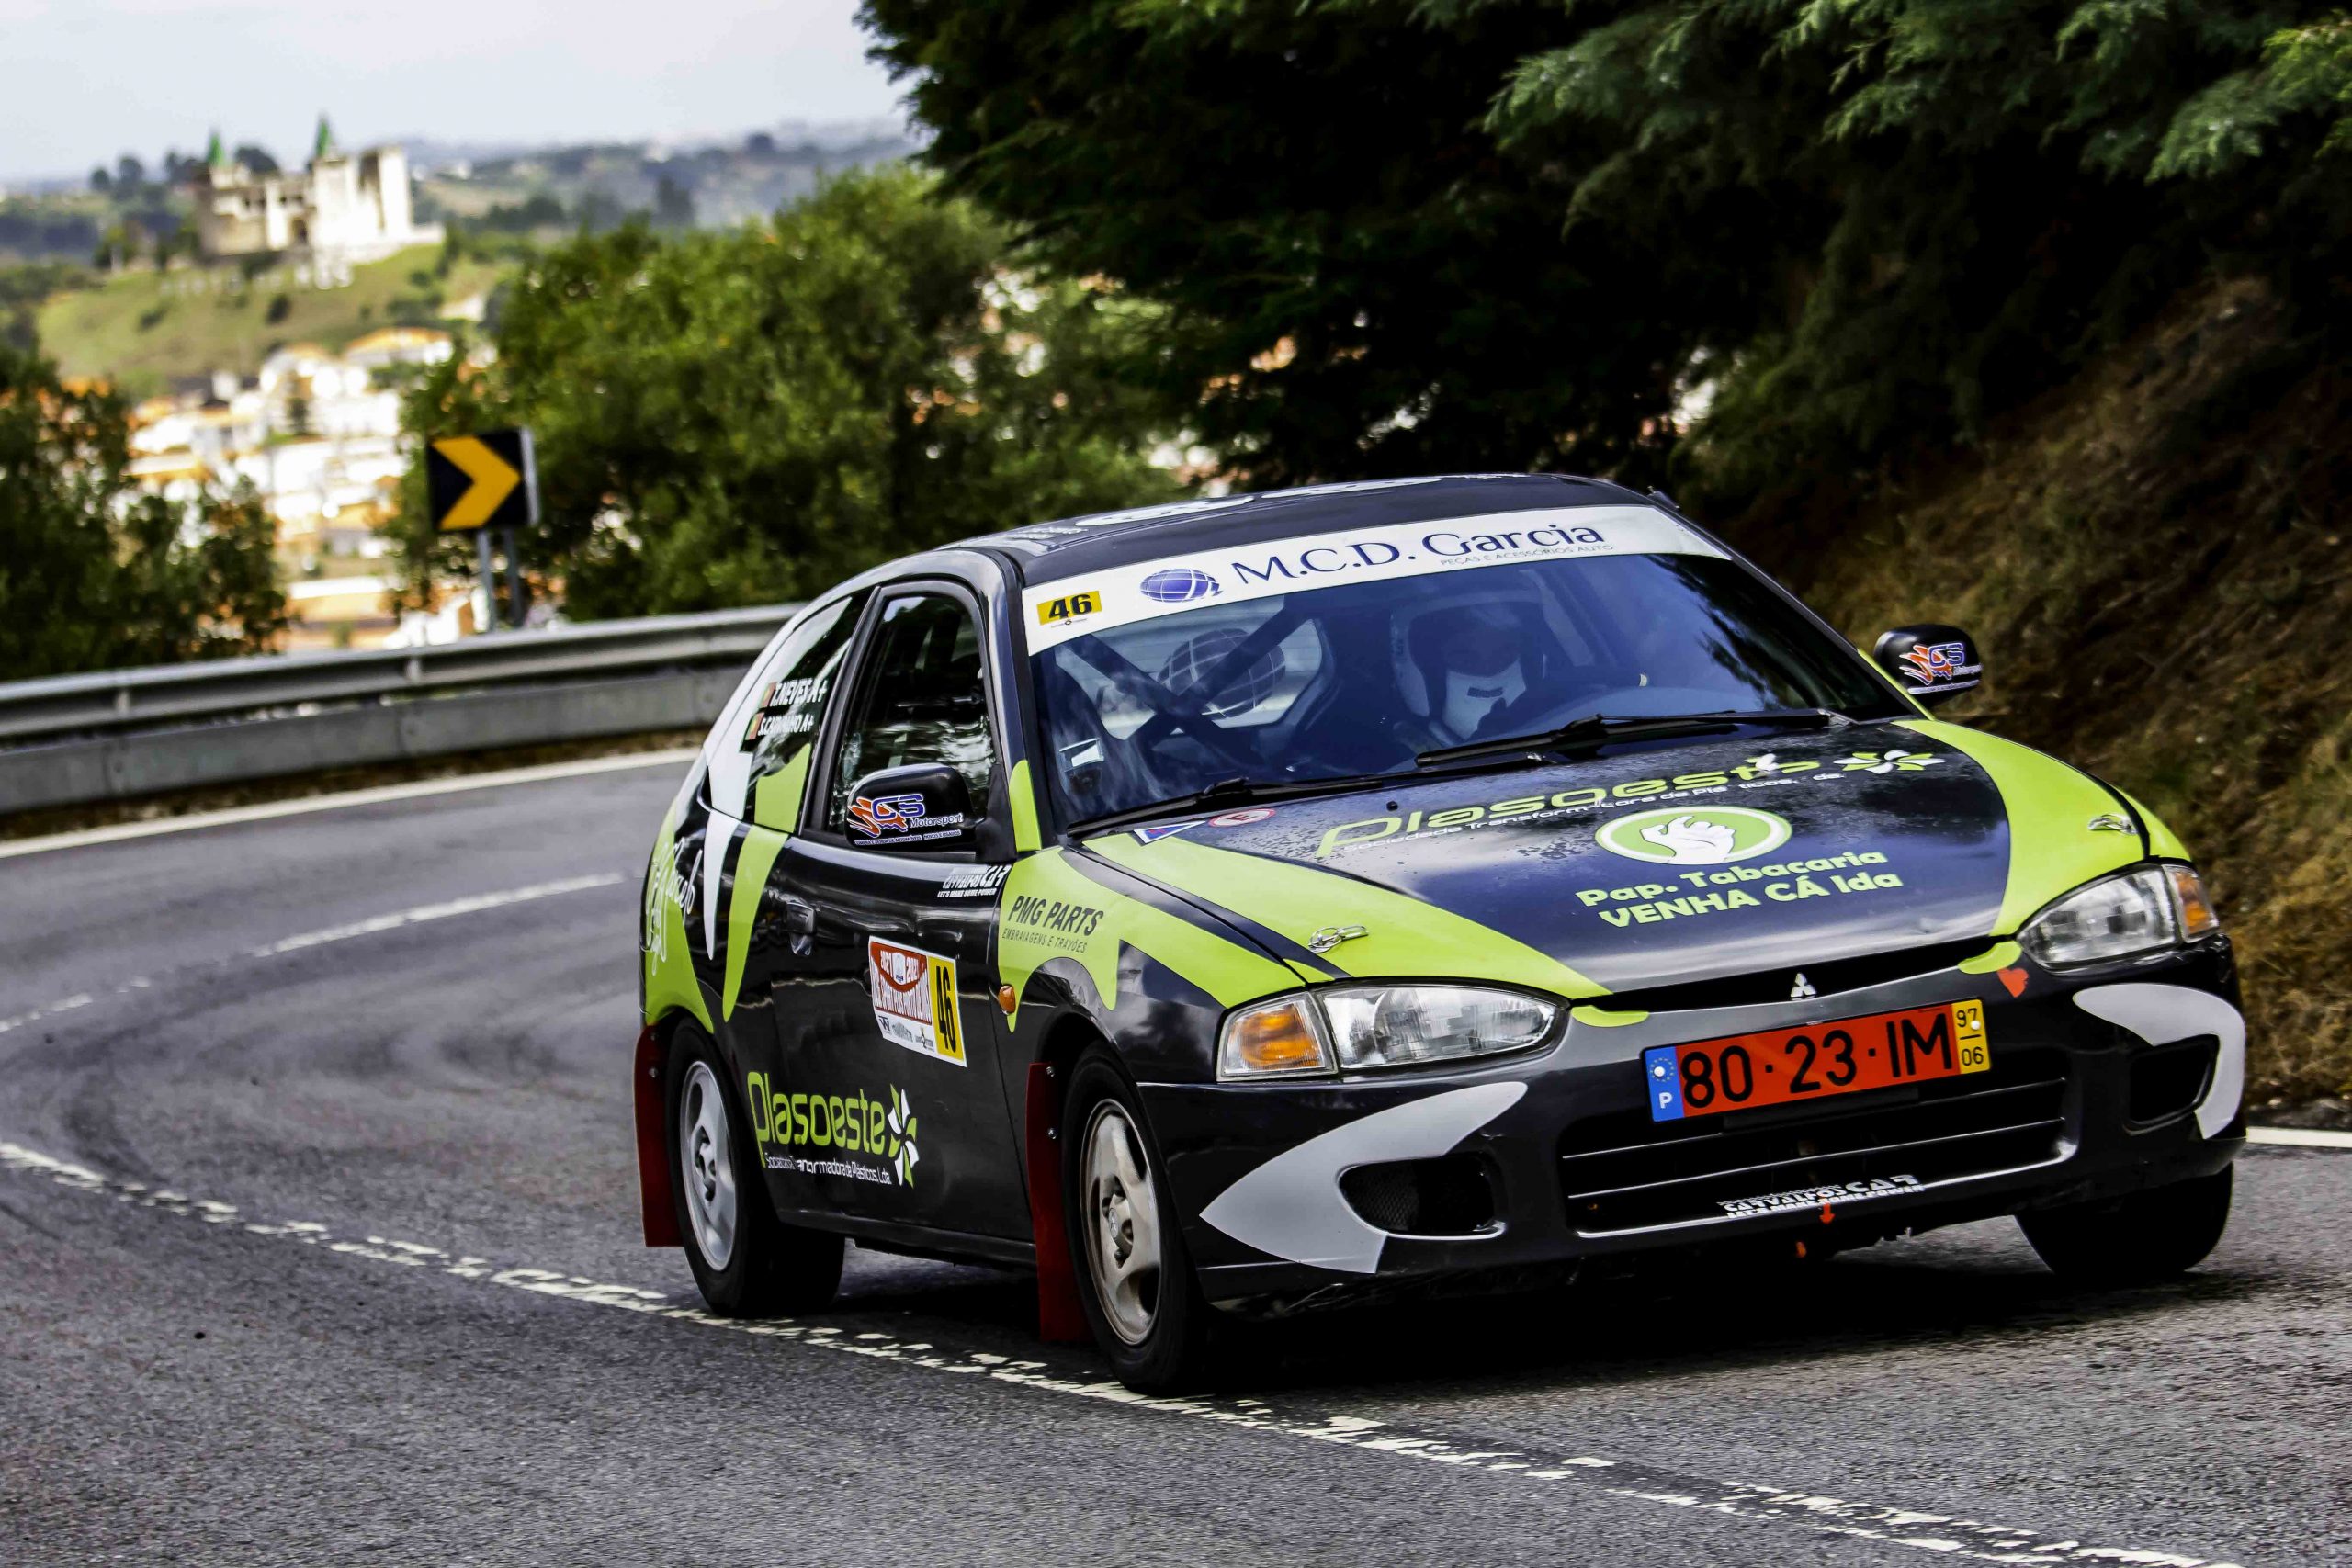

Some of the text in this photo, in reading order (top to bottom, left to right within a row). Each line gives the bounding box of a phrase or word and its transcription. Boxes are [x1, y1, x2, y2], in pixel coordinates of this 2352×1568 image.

[1231, 524, 1605, 585] M.C.D. Garcia
[1440, 556, 1480, 567] PEÇAS
[1485, 554, 1492, 562] E
[1577, 544, 1614, 553] AUTO
[1048, 593, 1093, 620] 46
[909, 812, 964, 829] Motorsport
[1574, 851, 1889, 908] Pap. Tabacaria
[1599, 887, 1762, 929] VENHA
[1764, 874, 1831, 902] CÁ
[1008, 895, 1104, 937] PMG PARTS
[1001, 927, 1046, 947] EMBRAIAGENS
[1046, 935, 1054, 948] E
[935, 965, 956, 1053] 46
[1956, 1007, 1978, 1028] 97
[1961, 1045, 1984, 1066] 06
[1657, 1091, 1673, 1109] P
[747, 1070, 886, 1168] Plasoeste
